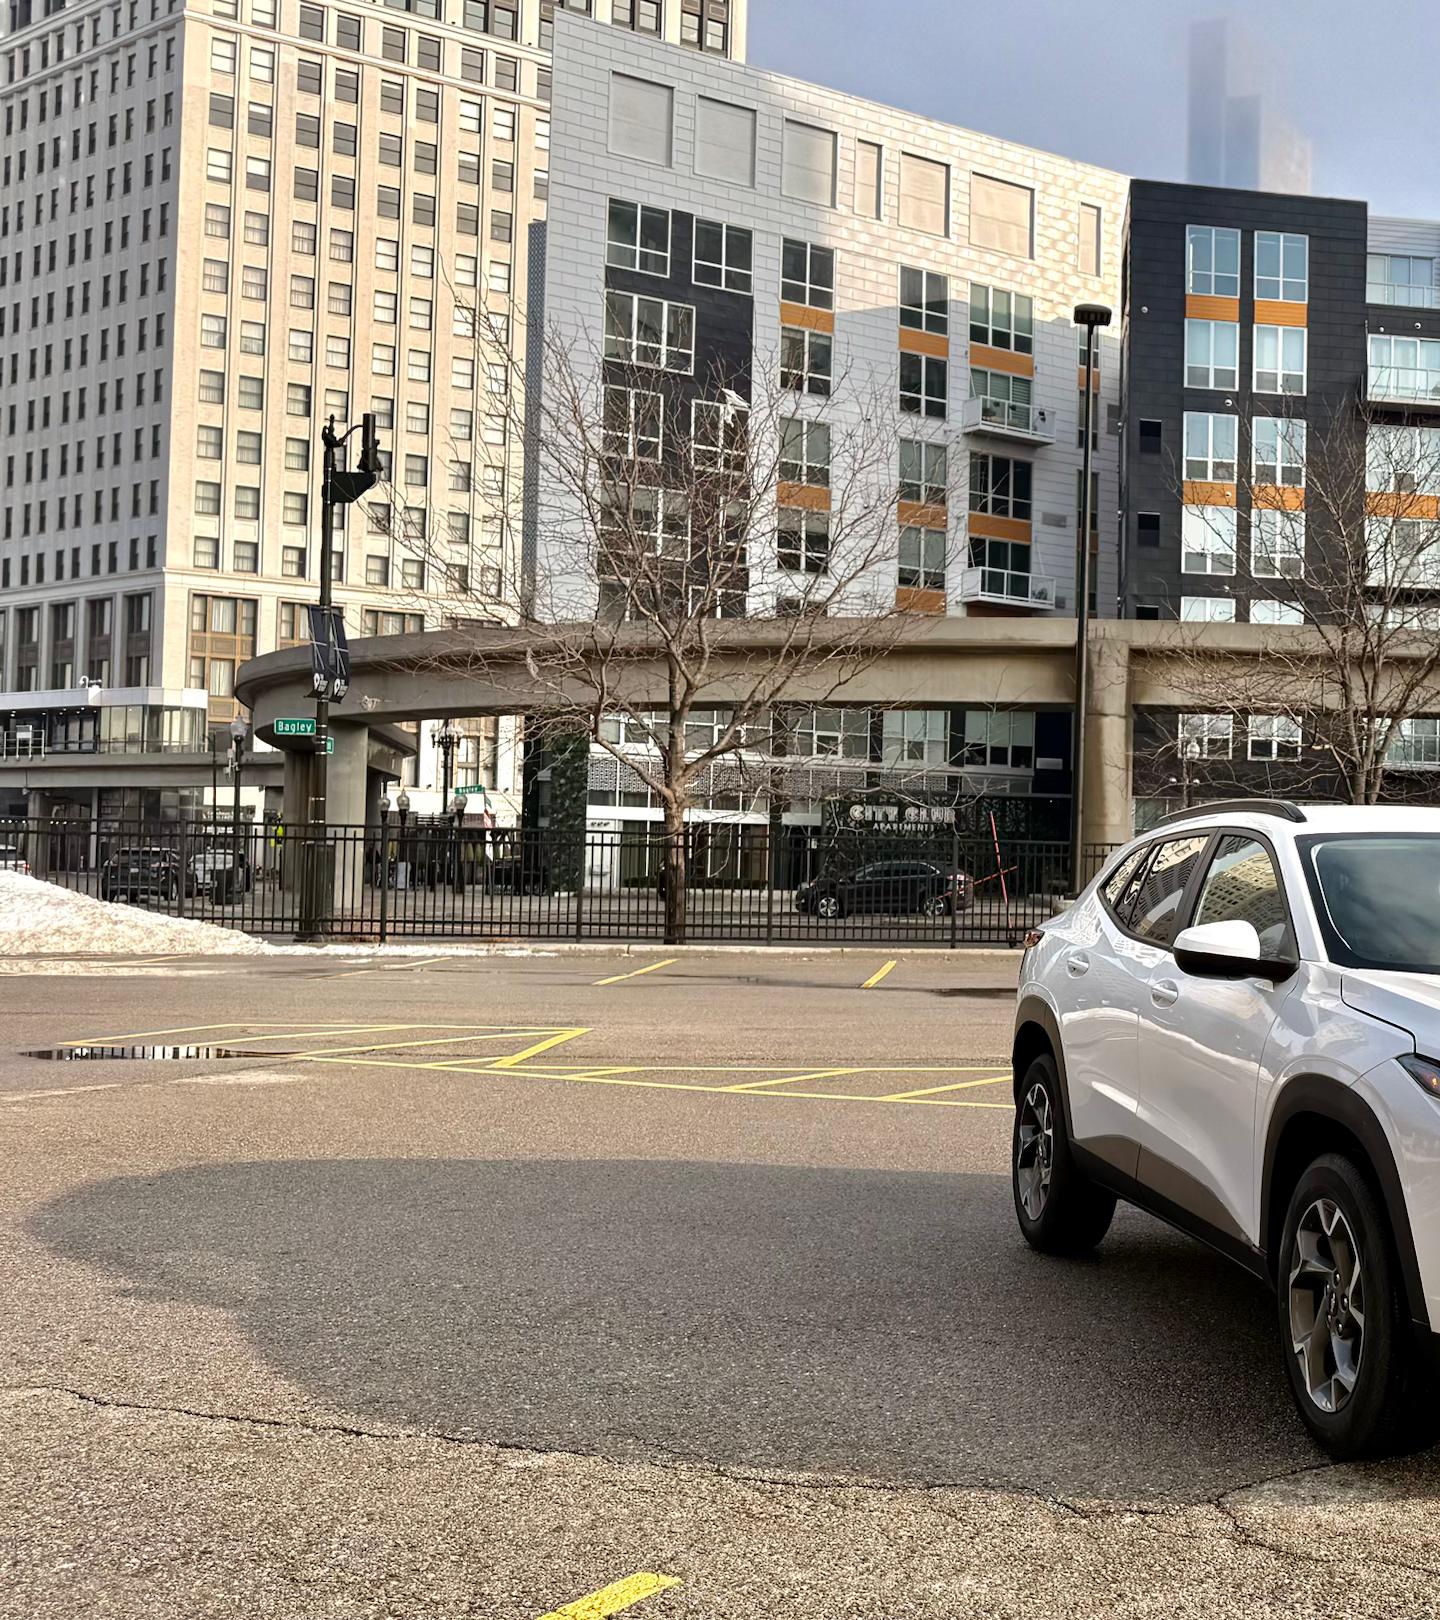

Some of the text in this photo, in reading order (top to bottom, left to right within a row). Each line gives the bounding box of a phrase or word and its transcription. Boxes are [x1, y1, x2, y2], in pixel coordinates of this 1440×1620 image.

[278, 721, 312, 733] Bagley
[849, 804, 956, 823] CITY CLUB
